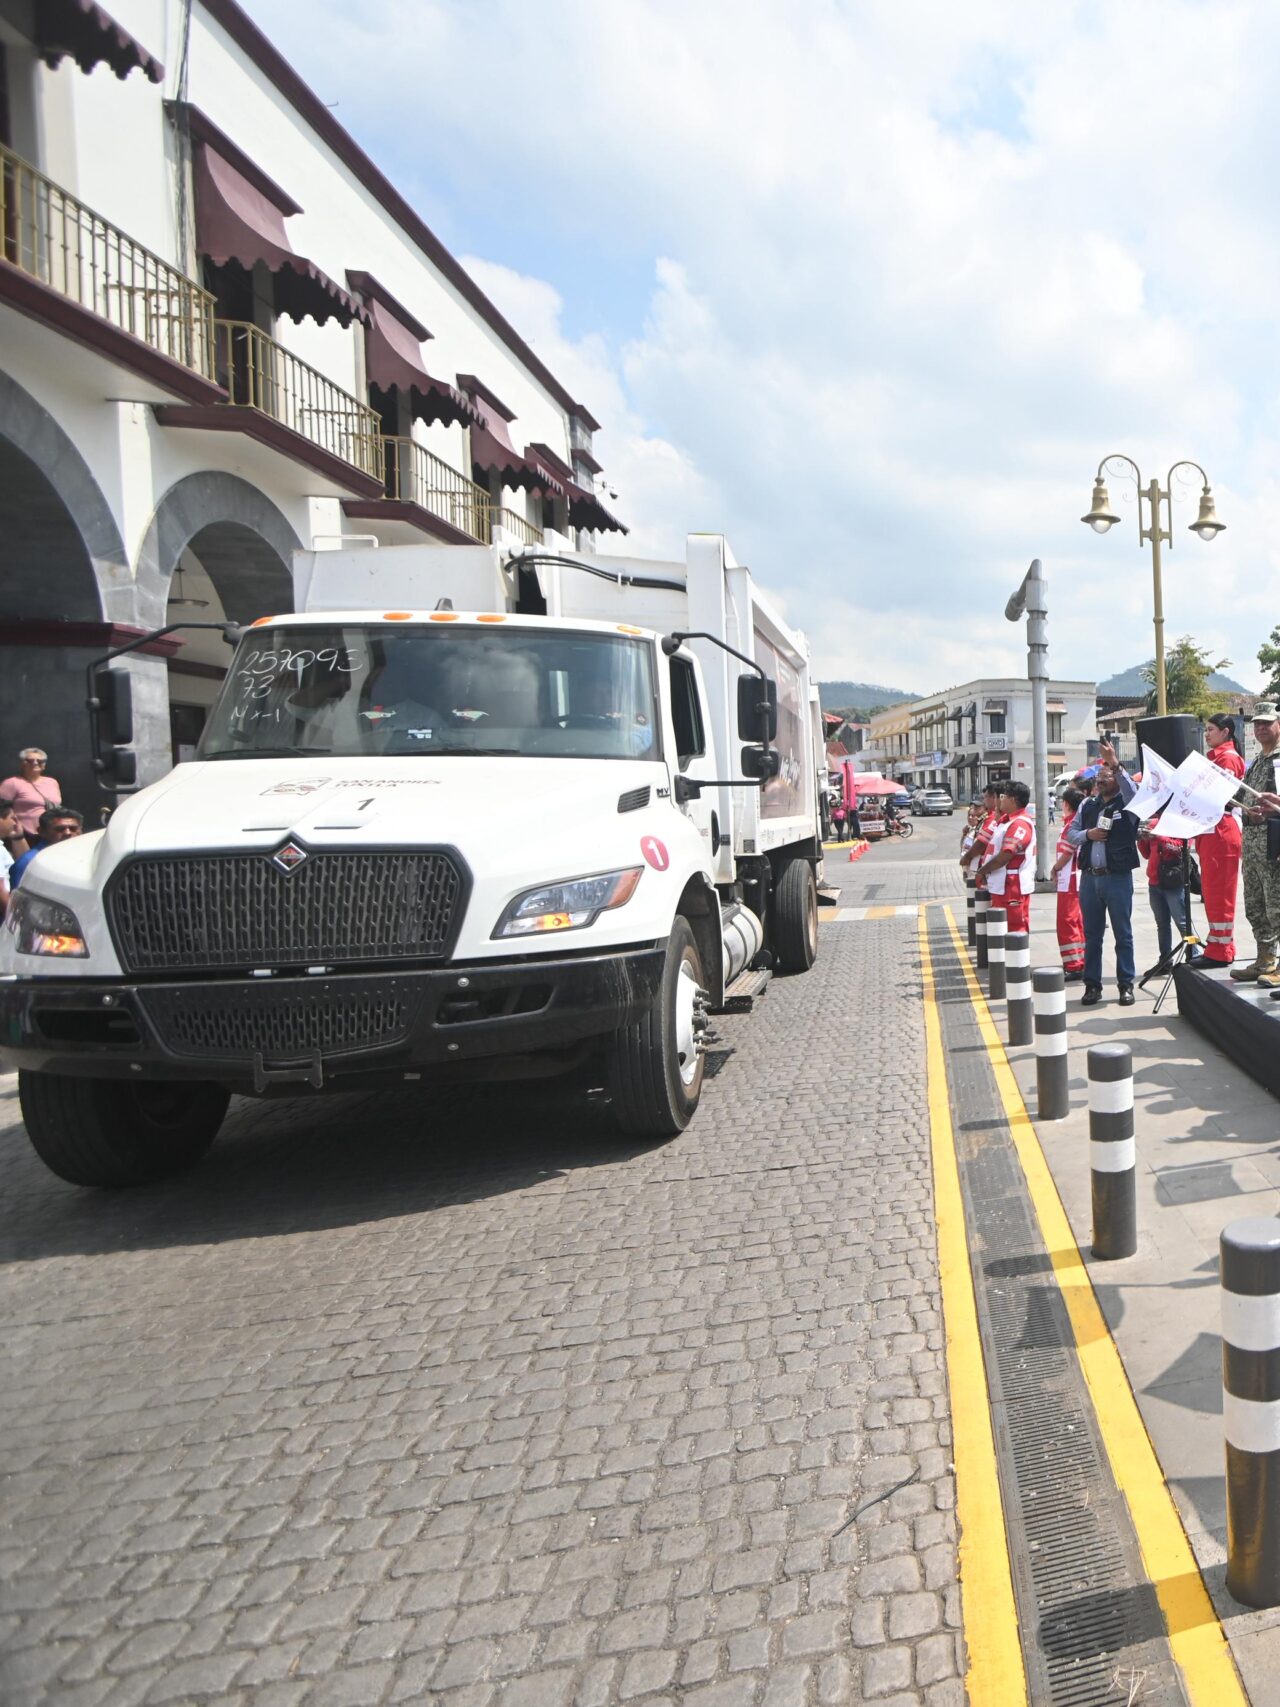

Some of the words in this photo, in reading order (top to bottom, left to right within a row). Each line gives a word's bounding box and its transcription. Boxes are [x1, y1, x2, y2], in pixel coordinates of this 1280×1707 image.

[244, 675, 274, 699] 73
[357, 798, 376, 811] 1
[648, 839, 665, 867] 1
